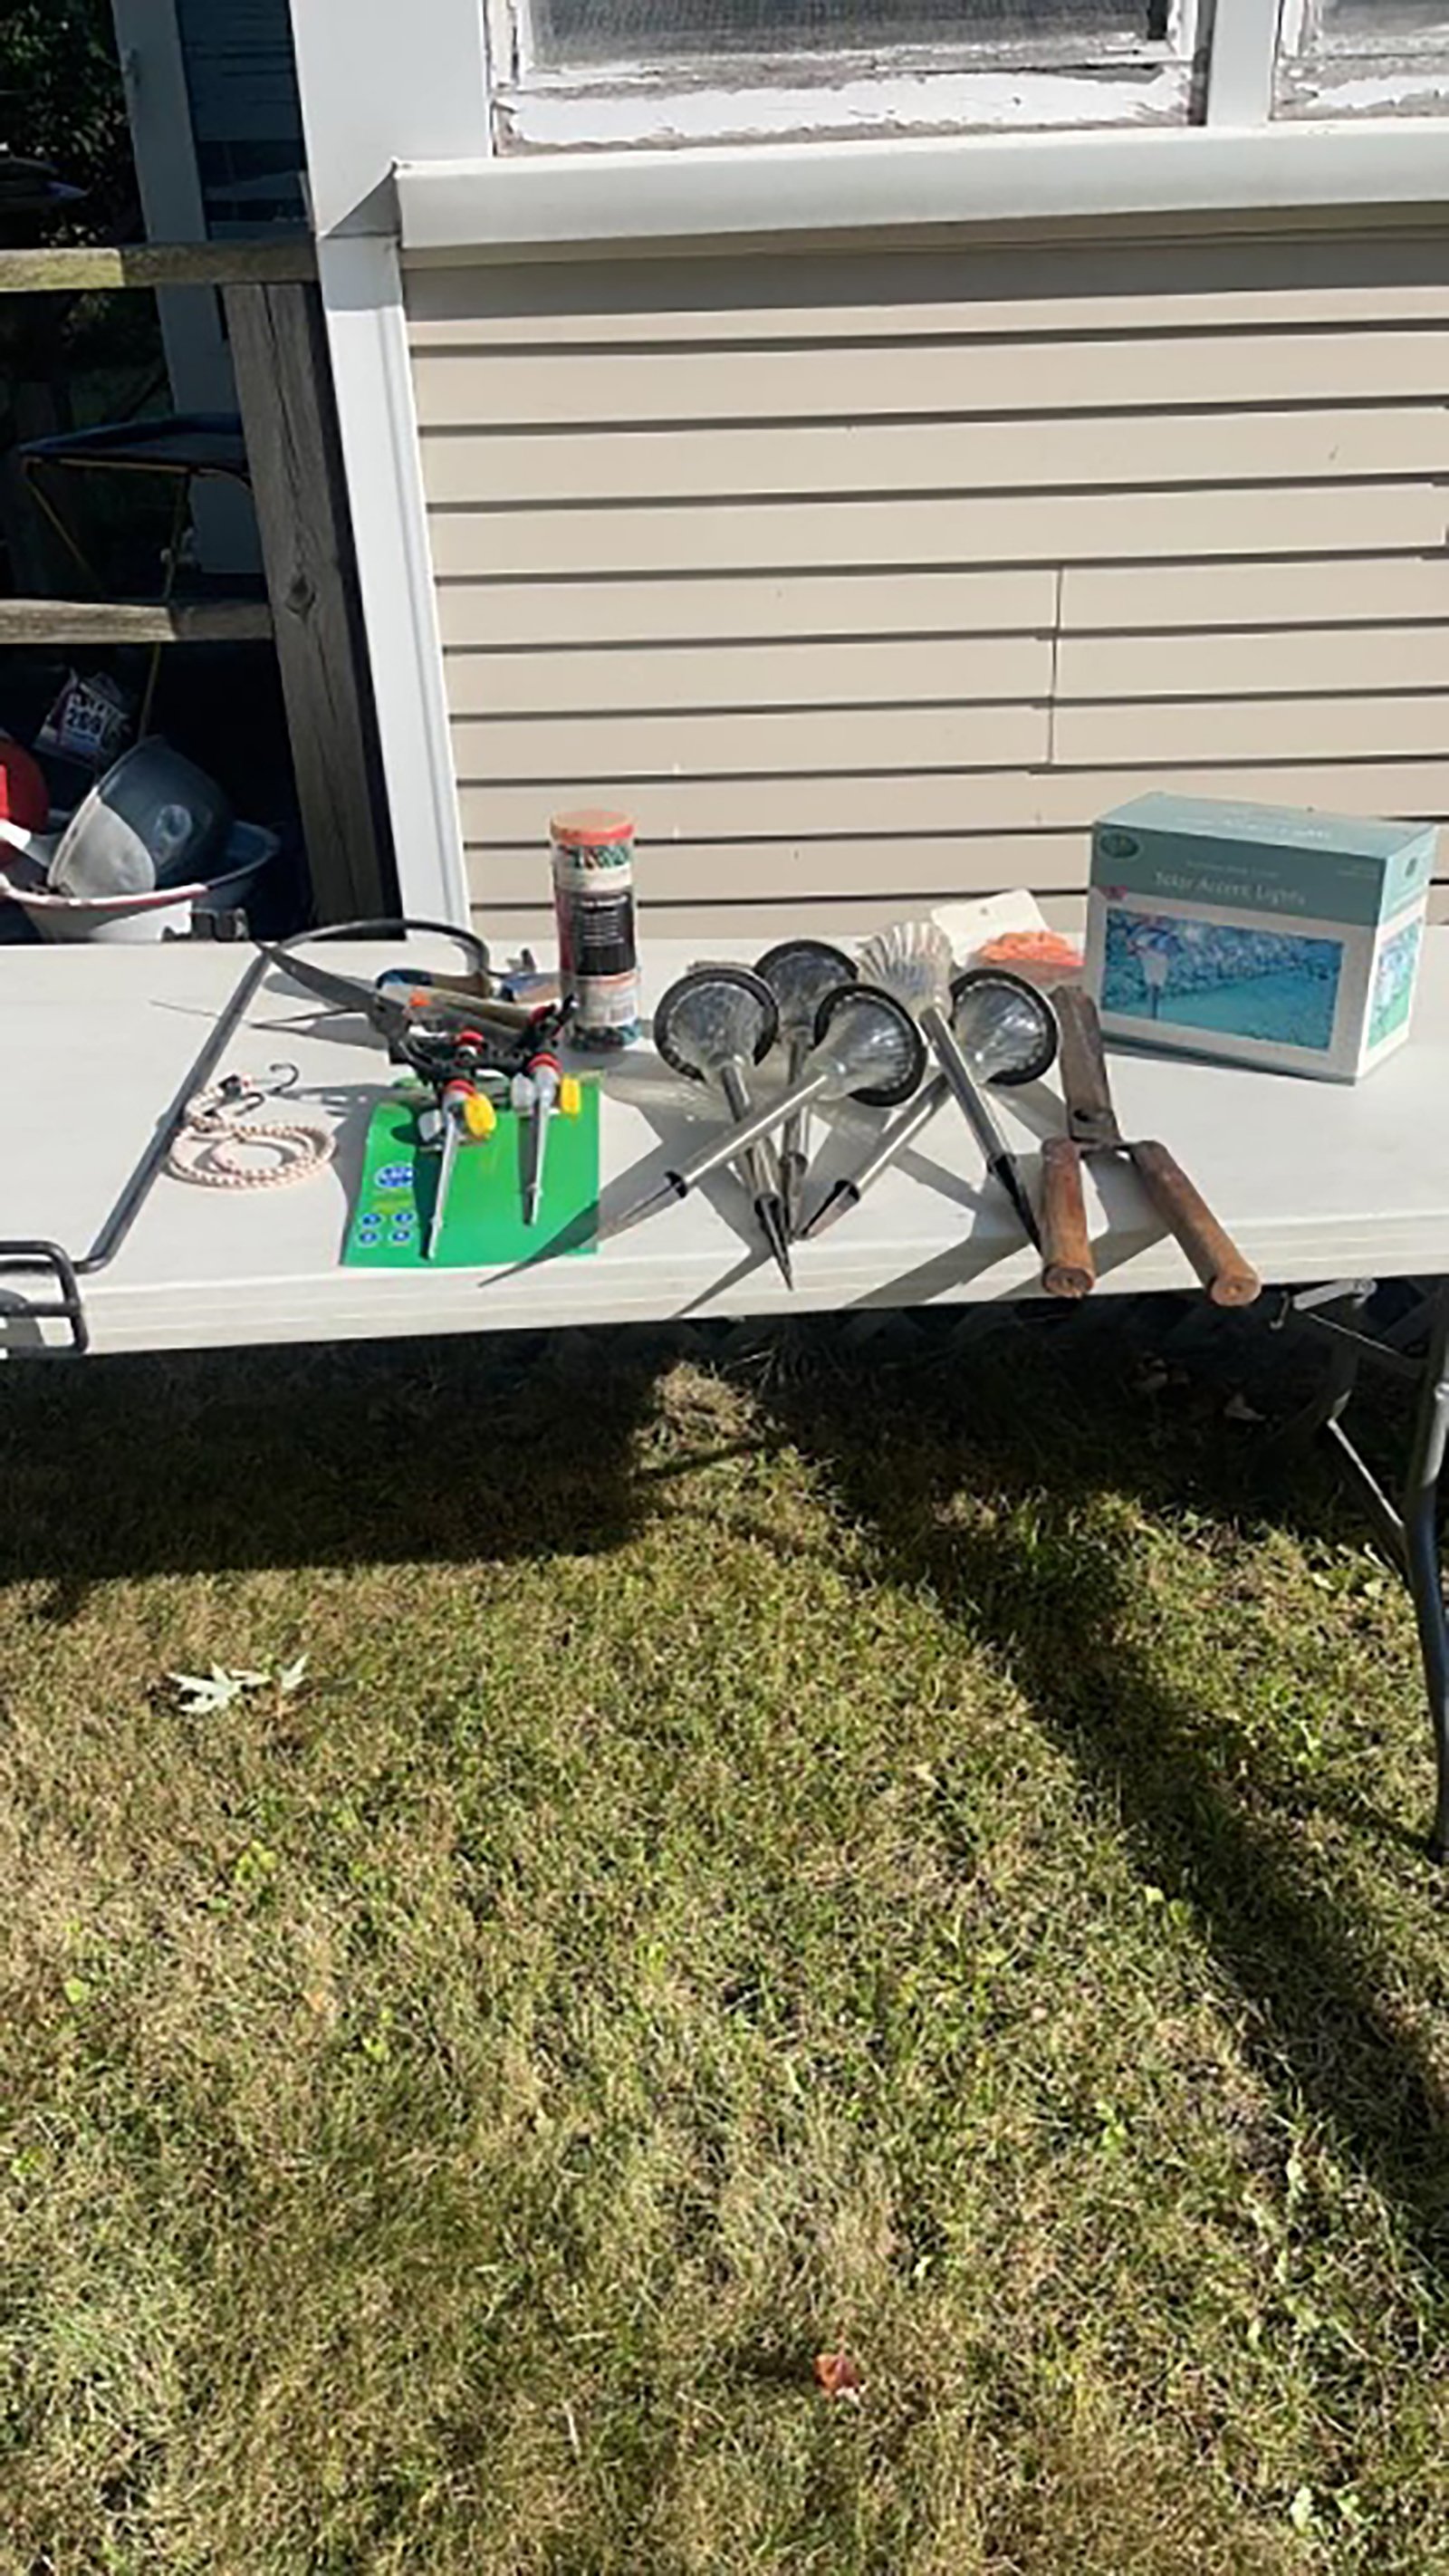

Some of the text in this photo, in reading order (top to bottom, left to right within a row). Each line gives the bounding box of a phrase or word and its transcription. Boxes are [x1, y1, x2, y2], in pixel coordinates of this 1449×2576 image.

[1155, 870, 1307, 907] Solar Accent Lights
